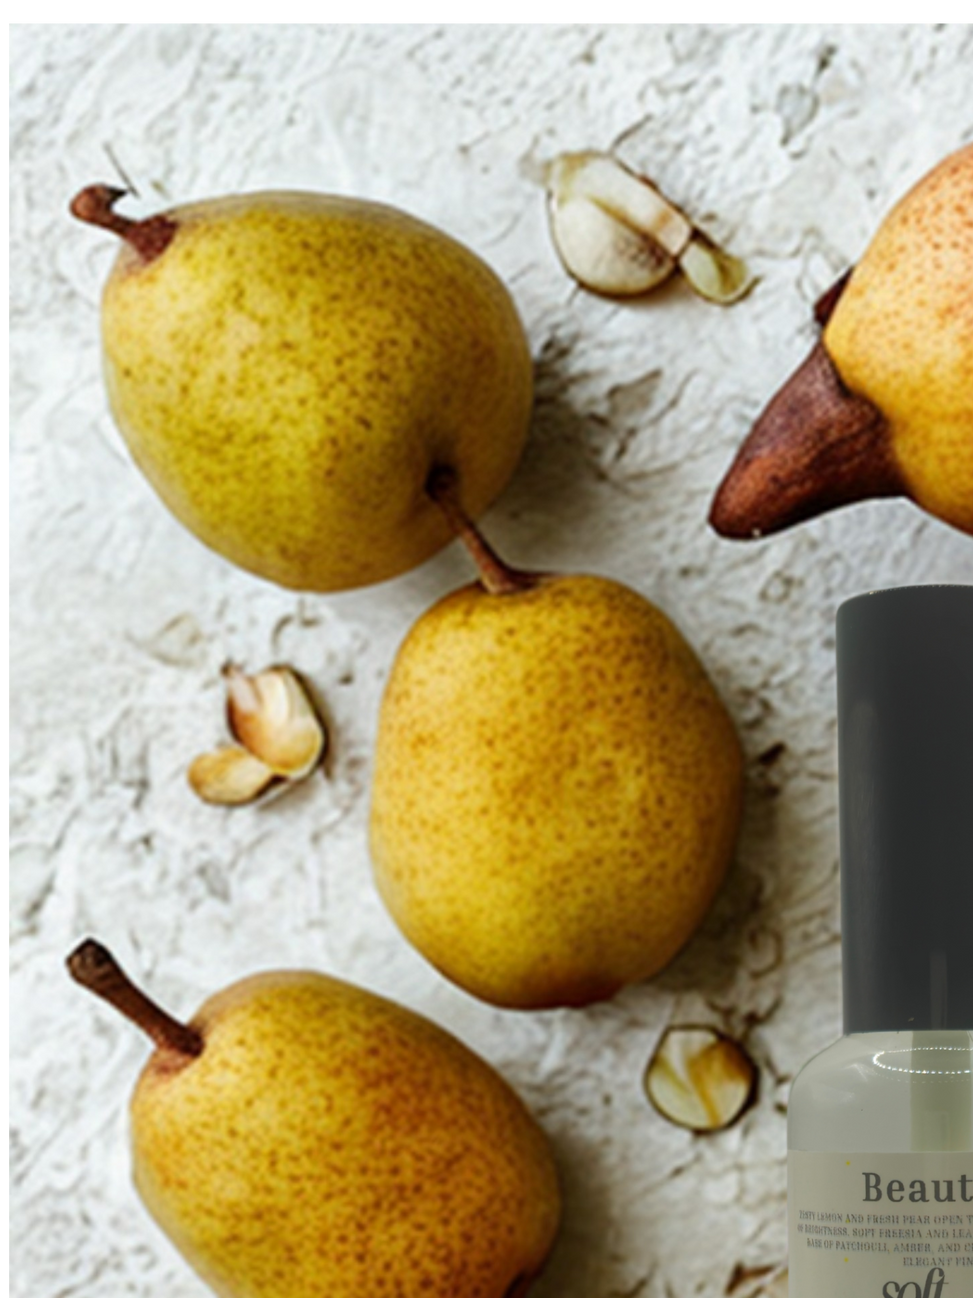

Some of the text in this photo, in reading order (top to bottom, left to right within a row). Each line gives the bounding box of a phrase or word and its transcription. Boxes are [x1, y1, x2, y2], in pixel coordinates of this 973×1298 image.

[817, 1211, 843, 1224] LEMON
[845, 1213, 864, 1225] AND
[867, 1214, 899, 1225] FRESH
[902, 1214, 931, 1225] PEAR
[934, 1214, 963, 1225] OPEN
[879, 1229, 922, 1239] FREESIA
[925, 1228, 949, 1239] AND
[824, 1239, 834, 1250] OF
[937, 1242, 961, 1253] AND
[903, 1256, 952, 1267] ELEGANT
